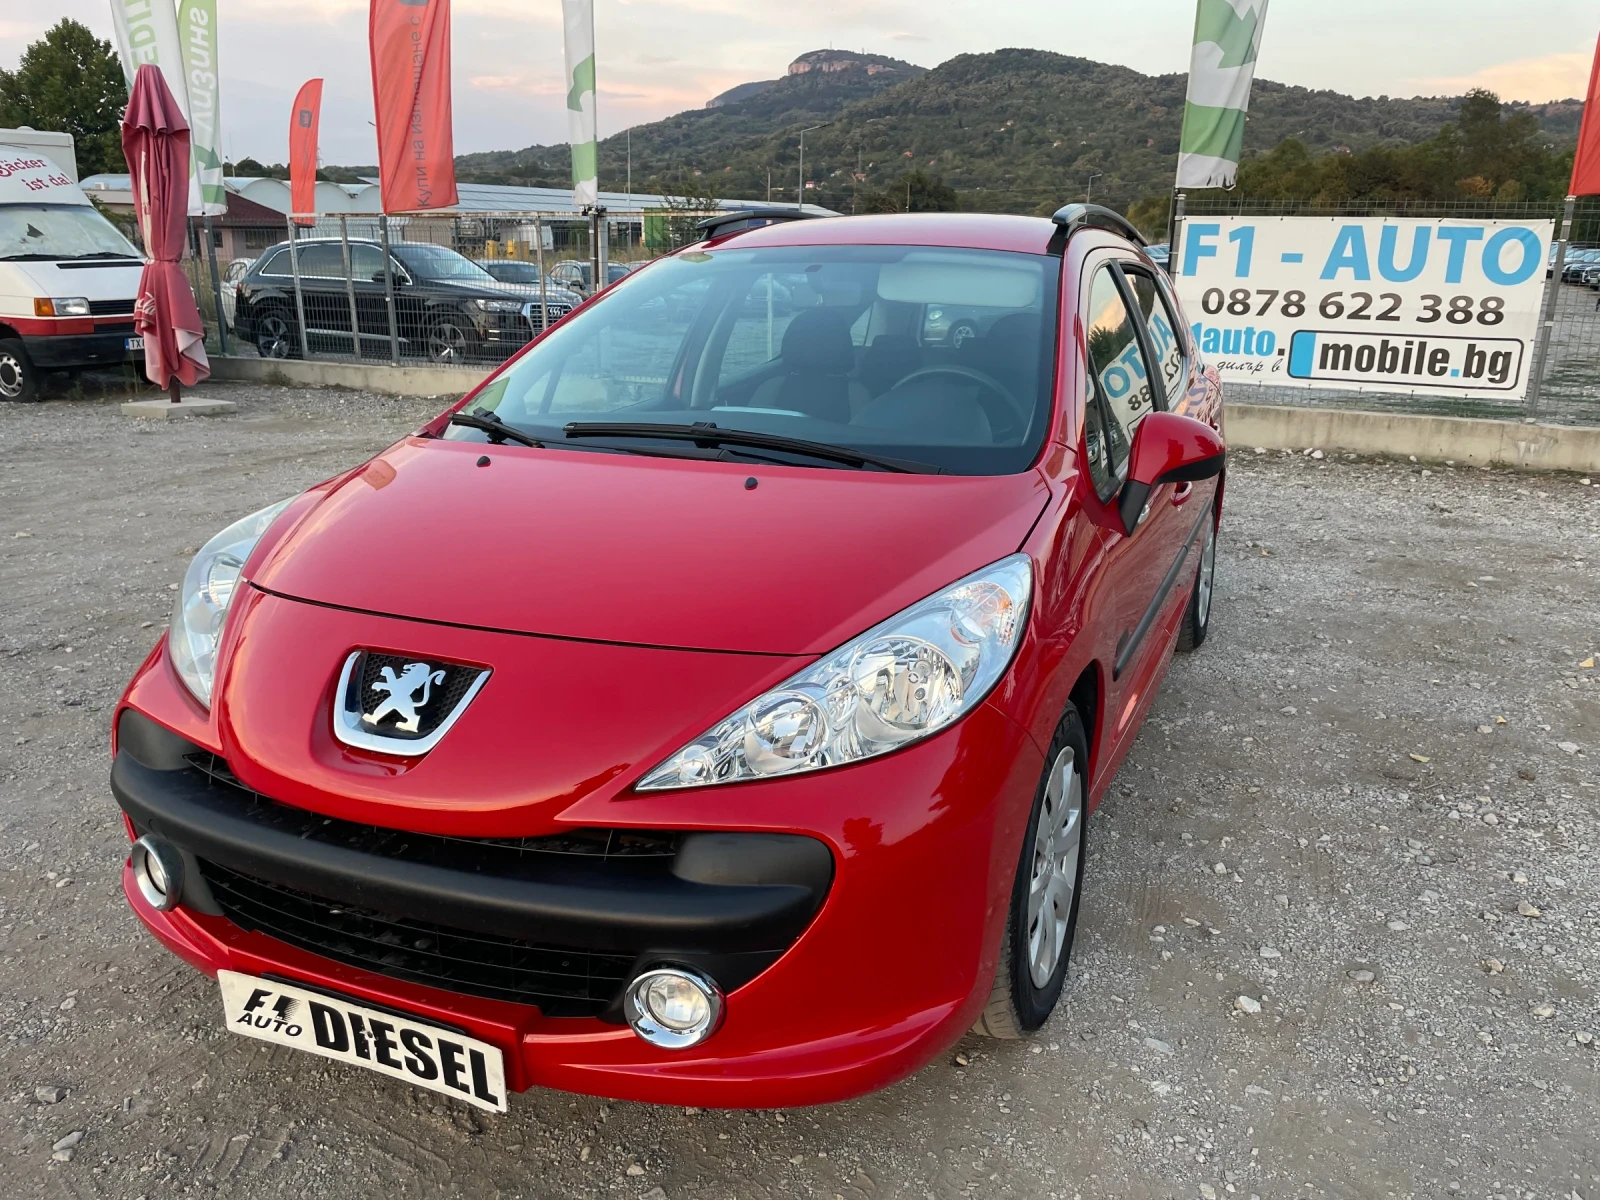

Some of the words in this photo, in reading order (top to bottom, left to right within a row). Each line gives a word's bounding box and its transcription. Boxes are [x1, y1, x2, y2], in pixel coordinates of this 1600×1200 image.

[413, 140, 425, 161] на
[21, 178, 50, 191] ist
[48, 173, 74, 187] da!
[417, 166, 432, 207] Купи
[1182, 223, 1255, 278] F1
[1319, 224, 1542, 286] AUTO
[1201, 287, 1306, 318] 0878
[1318, 291, 1402, 322] 622
[1416, 294, 1505, 326] 388
[132, 339, 145, 349] TX
[1318, 339, 1512, 384] mobile.bg
[236, 1012, 303, 1037] AUTO
[309, 1000, 499, 1106] DIESEL
